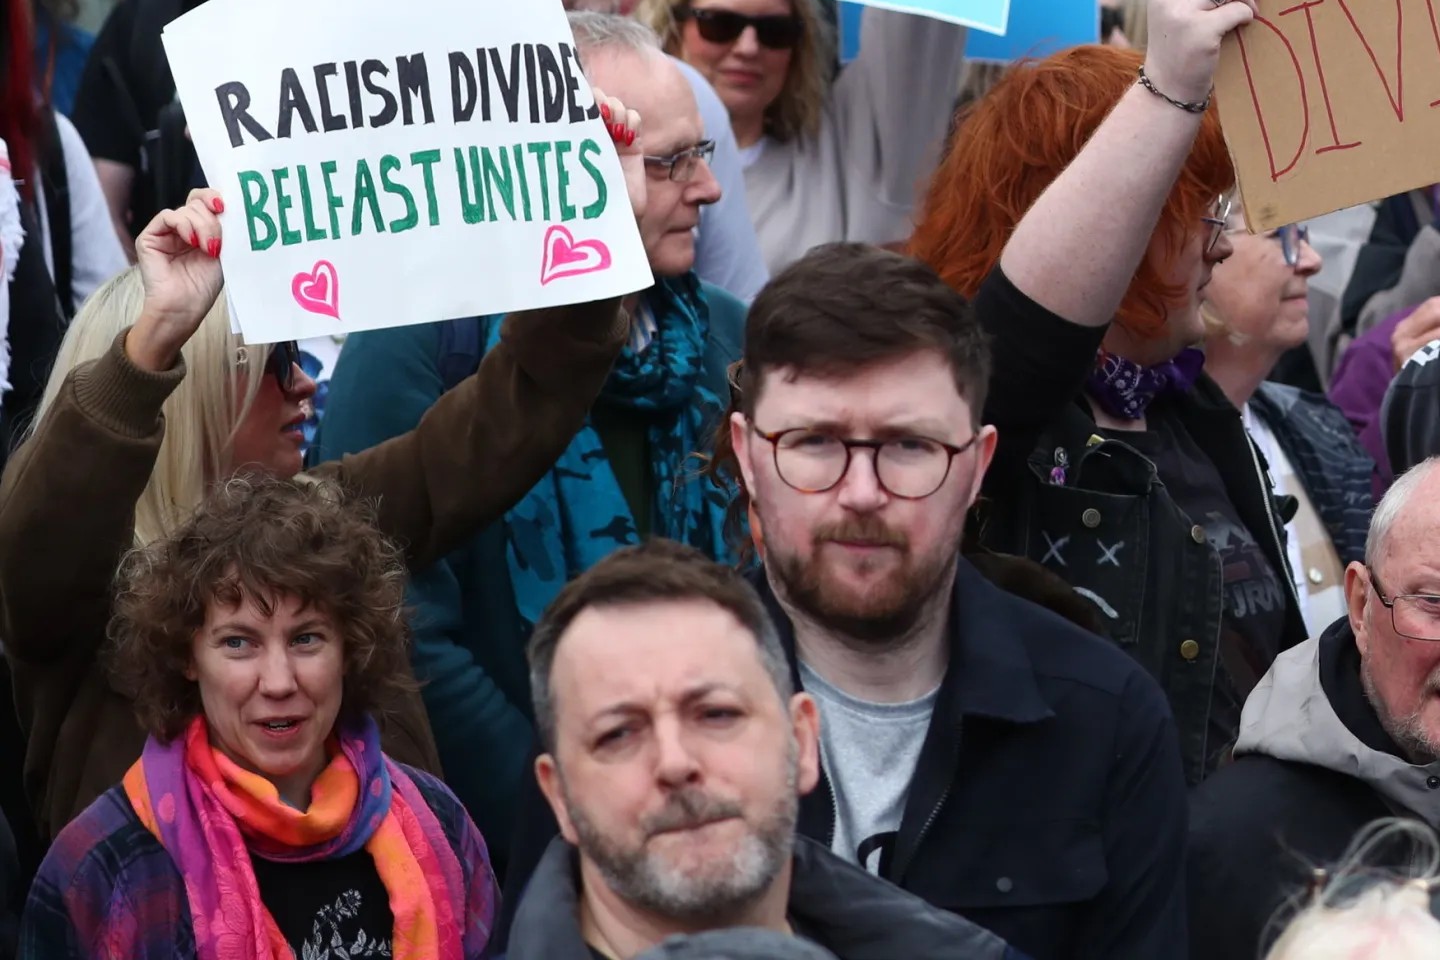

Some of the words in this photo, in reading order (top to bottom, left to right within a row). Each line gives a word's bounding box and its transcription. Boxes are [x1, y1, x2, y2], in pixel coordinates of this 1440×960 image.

[215, 52, 435, 148] RACISM
[237, 148, 442, 252] BELFAST
[454, 138, 608, 225] UNITES
